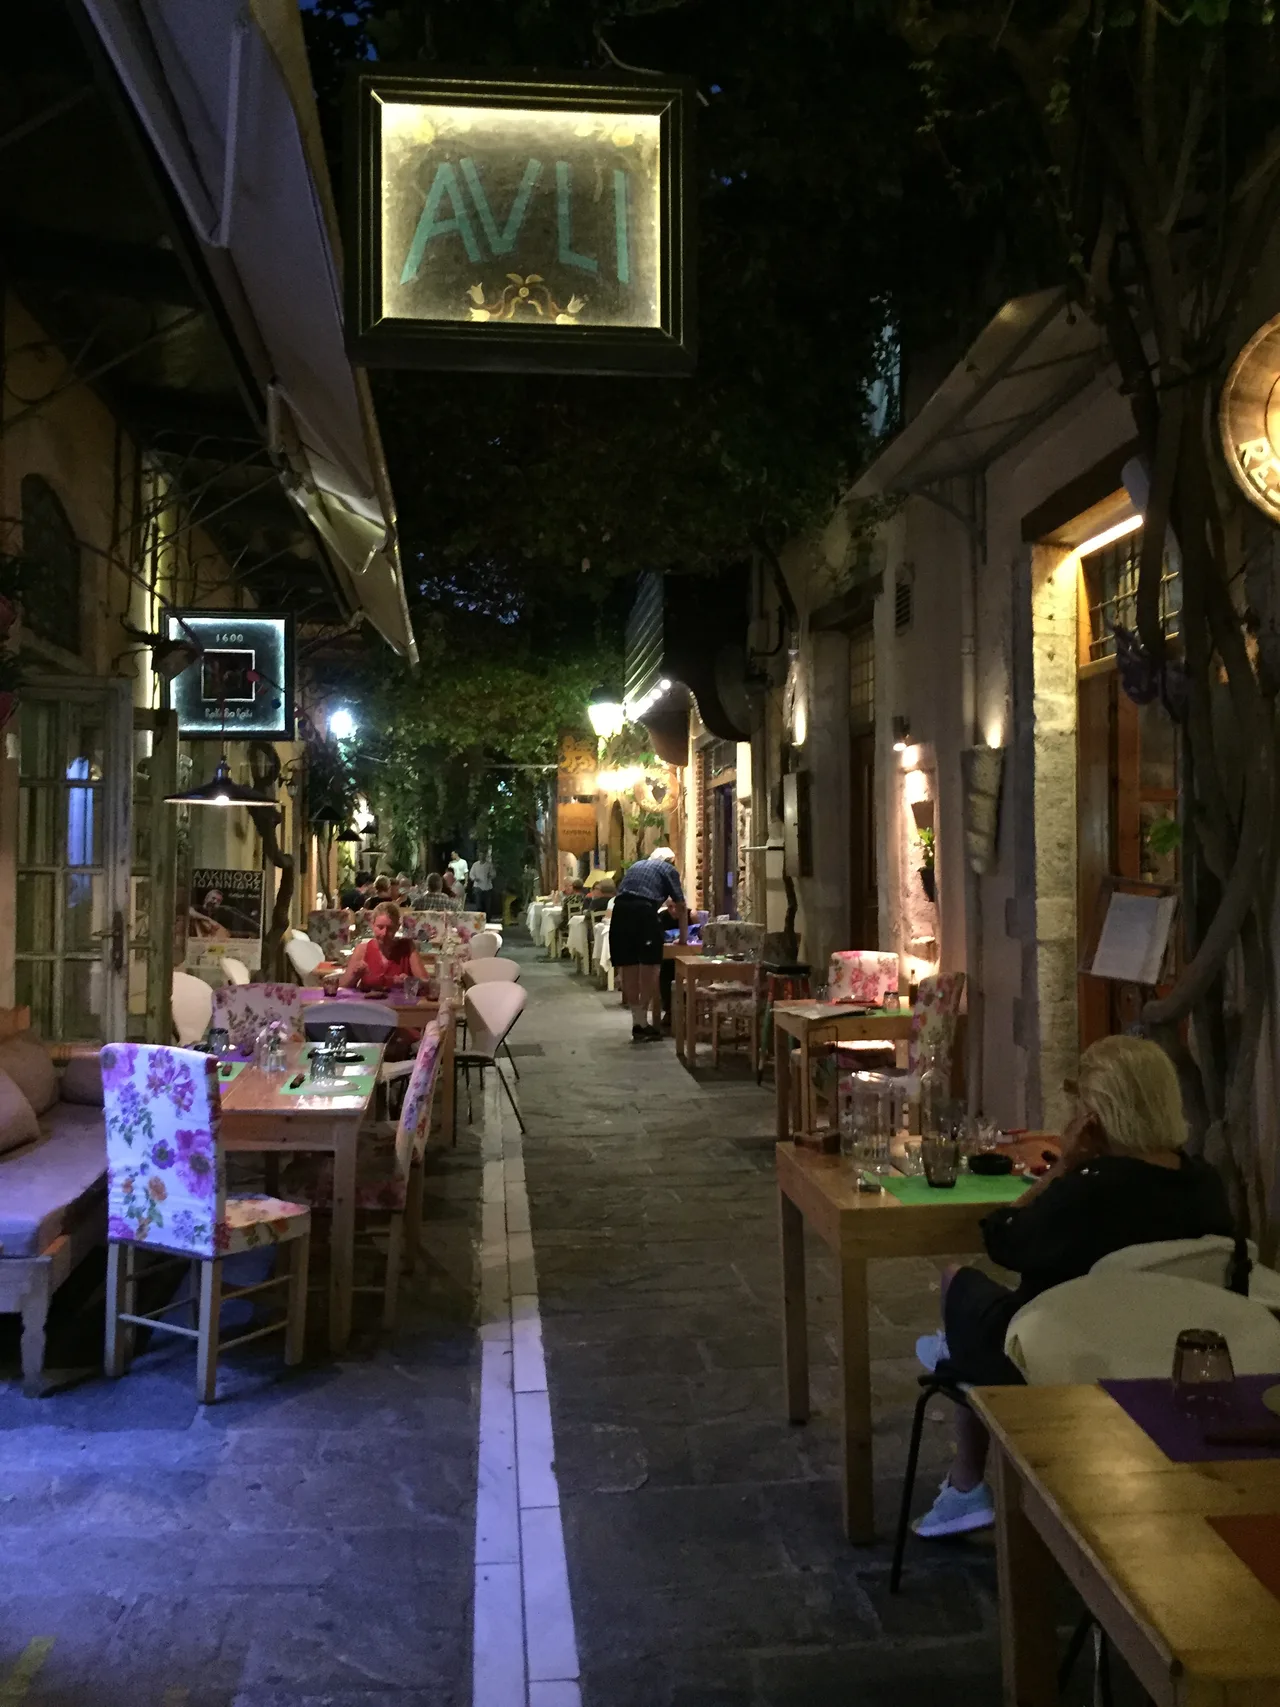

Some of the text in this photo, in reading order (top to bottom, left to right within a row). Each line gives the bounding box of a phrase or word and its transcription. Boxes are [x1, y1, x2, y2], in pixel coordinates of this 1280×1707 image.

[399, 156, 631, 285] AVLI
[215, 633, 244, 643] 1600
[193, 870, 261, 881] ΑΛΚΙΝΟΟΣ
[193, 879, 261, 889] ΙΩΑΝΝΙΔΗΣ
